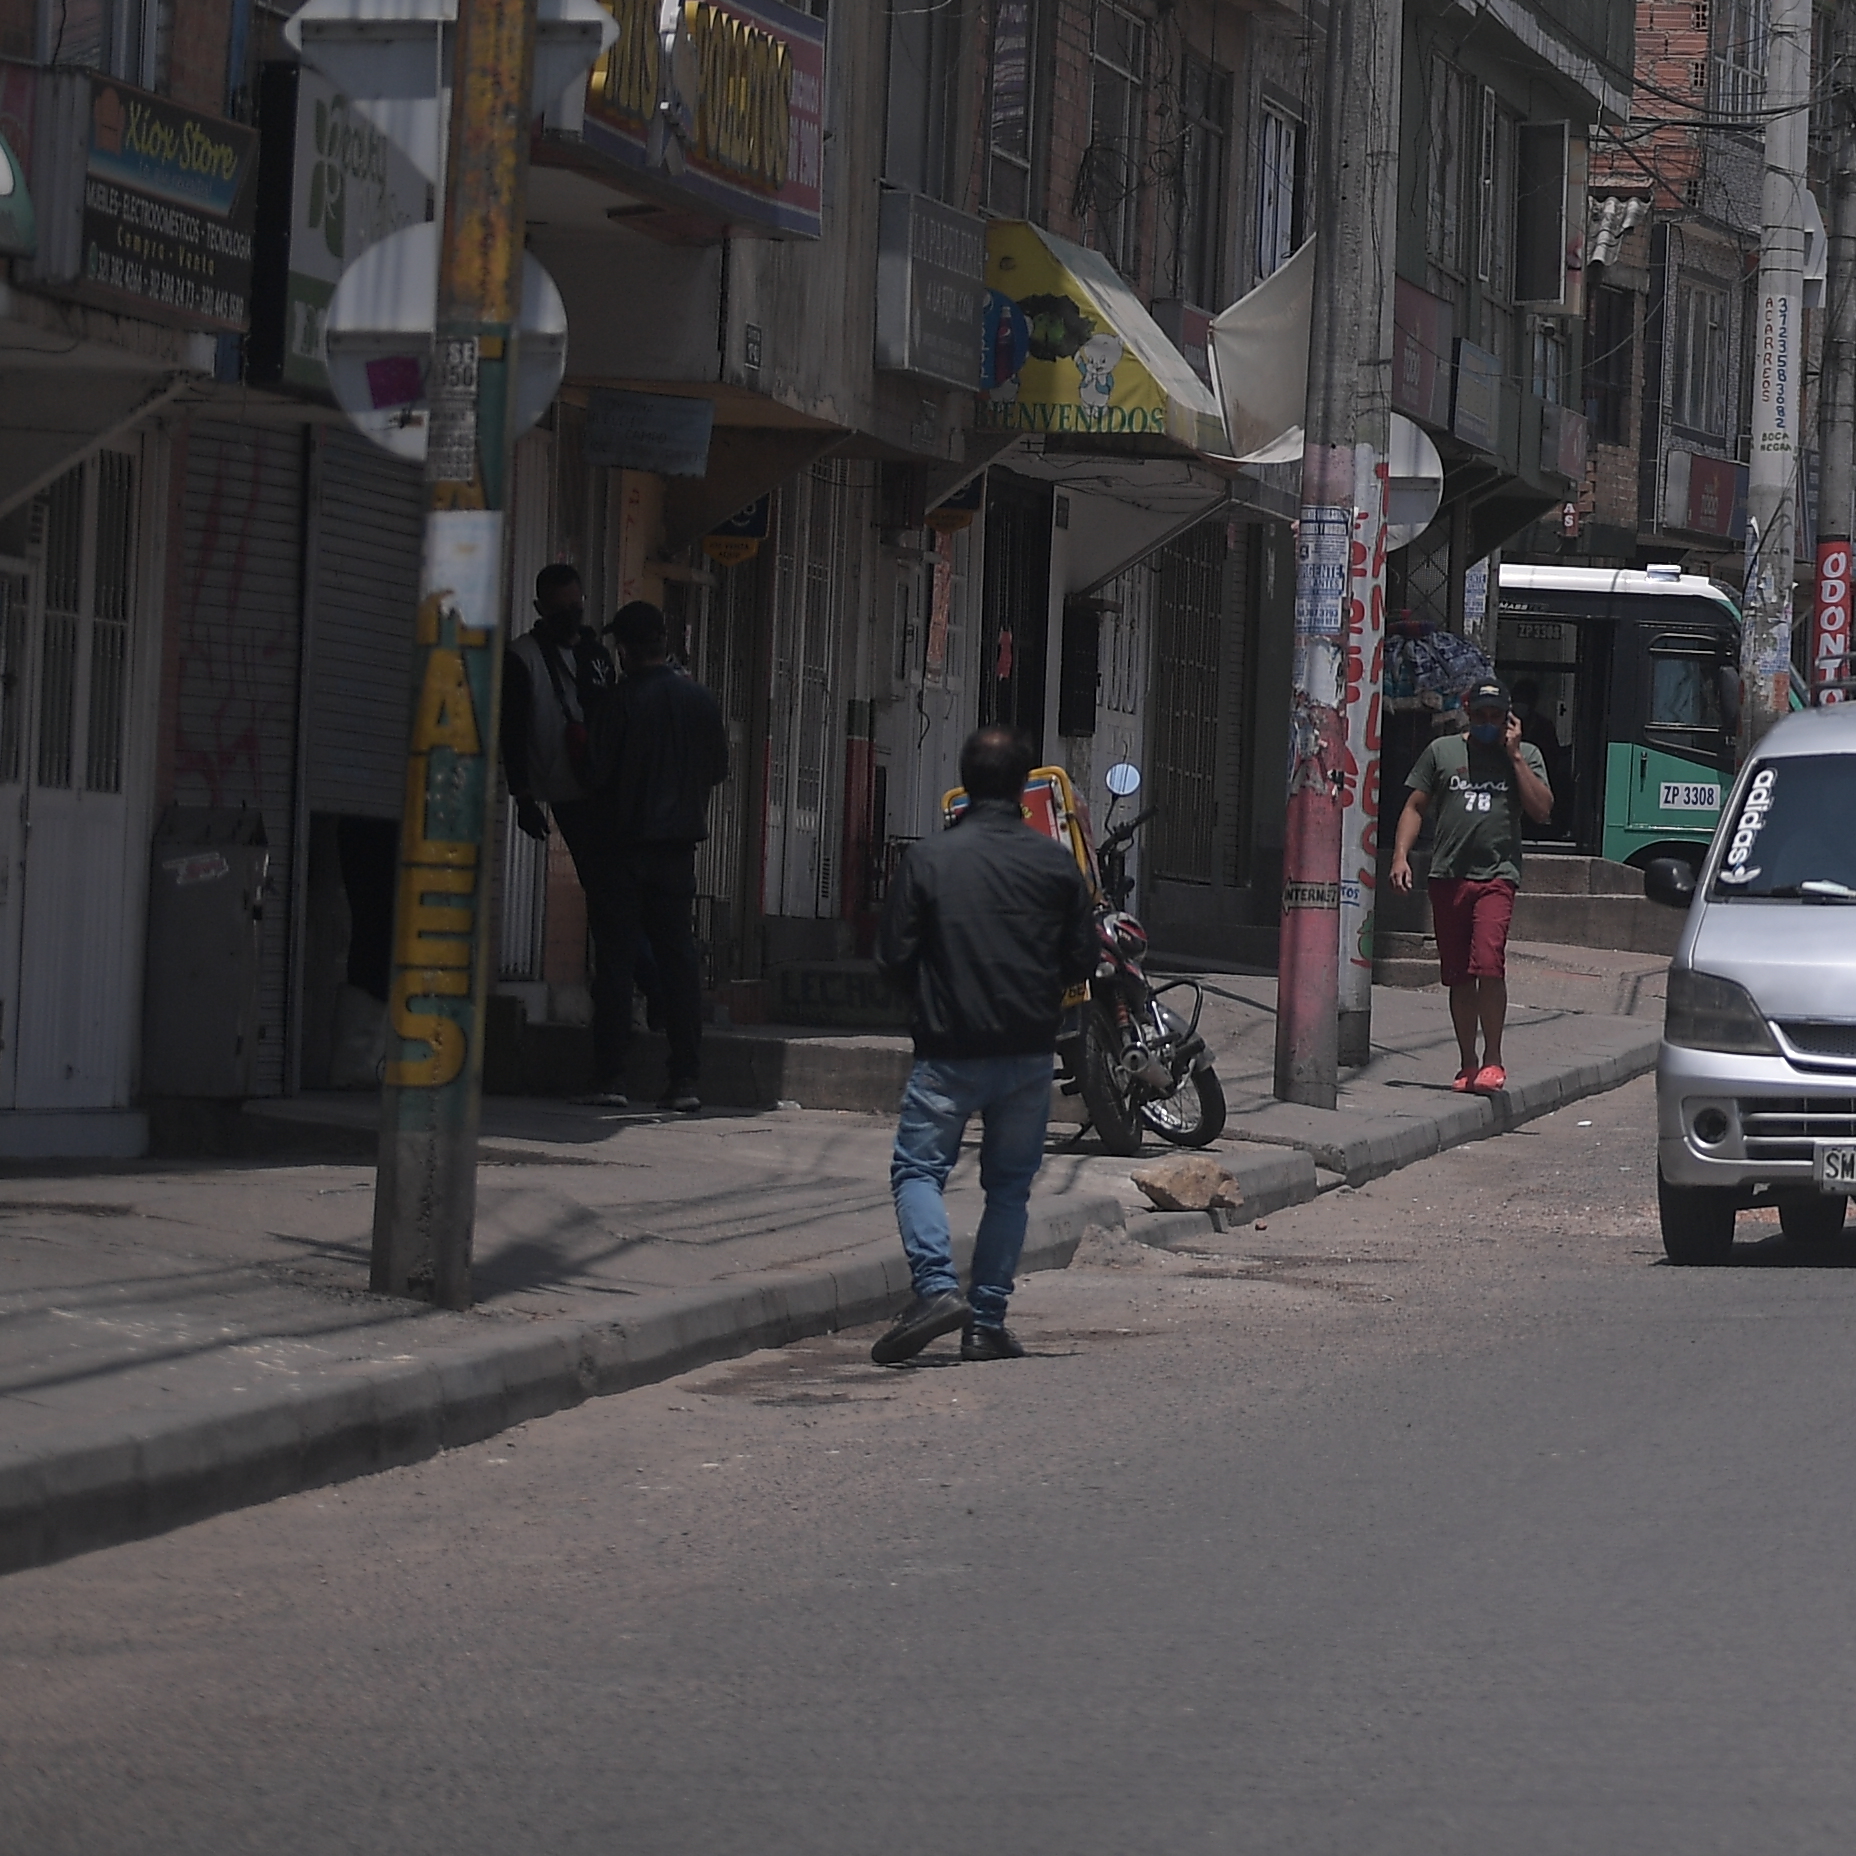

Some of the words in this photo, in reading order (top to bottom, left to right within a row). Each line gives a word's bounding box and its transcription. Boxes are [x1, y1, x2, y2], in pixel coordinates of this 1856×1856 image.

[1762, 297, 1774, 403] ACARREOS
[974, 401, 1165, 434] BIENVENIDOS
[1299, 564, 1342, 579] RGENTE
[1464, 790, 1491, 812] 78
[1663, 785, 1681, 804] ZP
[1683, 786, 1714, 806] 3308
[1727, 768, 1775, 866] adidas
